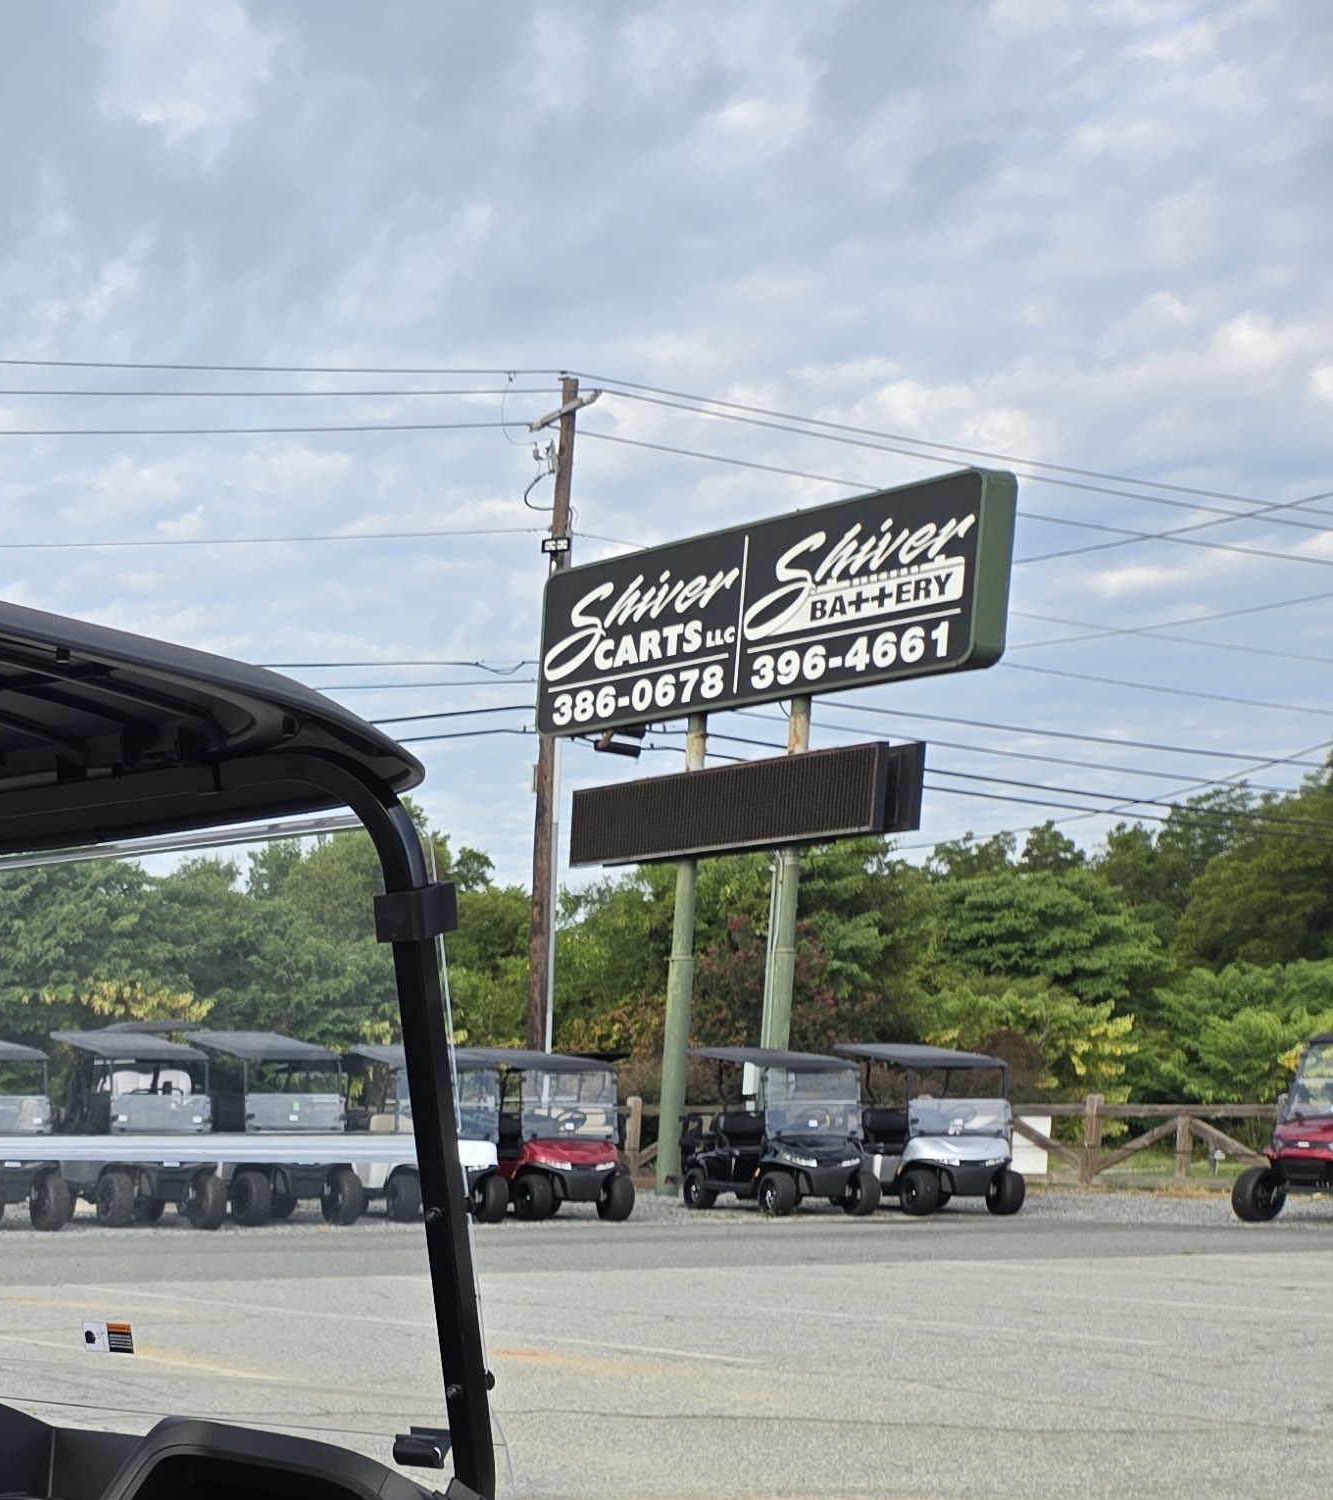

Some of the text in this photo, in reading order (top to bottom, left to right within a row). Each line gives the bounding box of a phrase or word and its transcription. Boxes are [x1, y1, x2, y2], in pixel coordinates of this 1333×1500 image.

[743, 514, 976, 641] Shiver
[544, 567, 740, 682] Shiver
[594, 620, 736, 671] CARTS LLC
[750, 620, 950, 690] 396-4661
[552, 664, 724, 726] 386-0678
